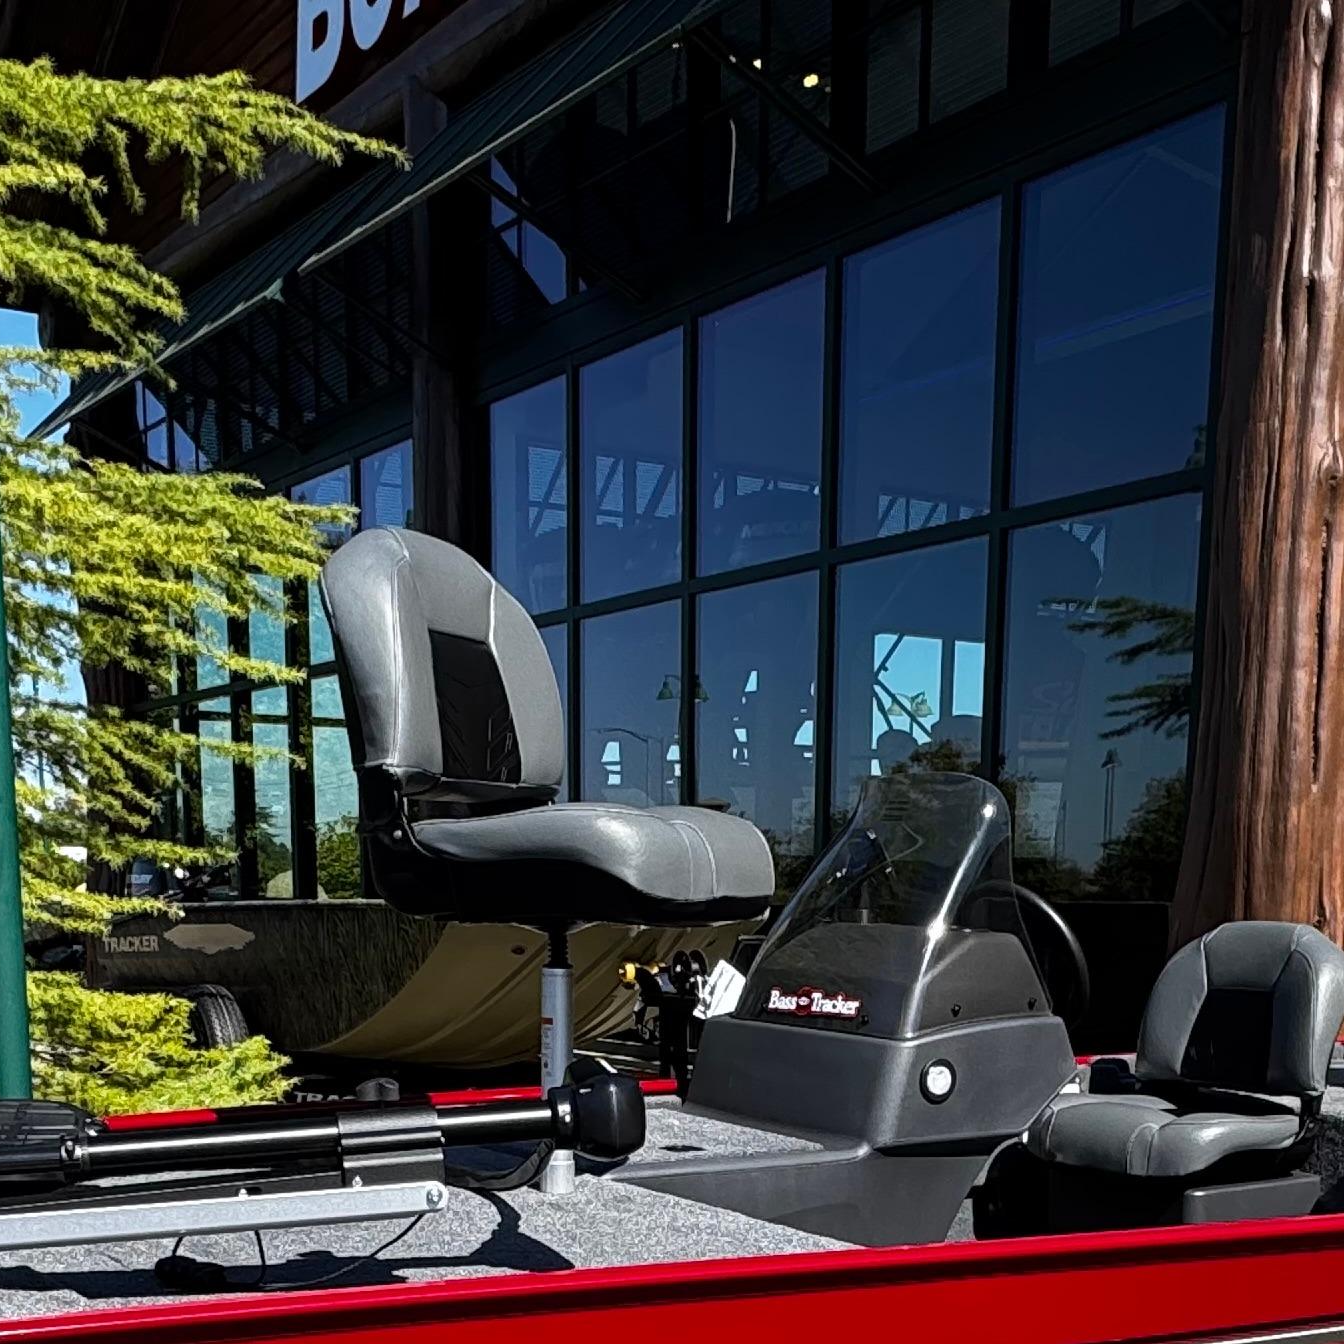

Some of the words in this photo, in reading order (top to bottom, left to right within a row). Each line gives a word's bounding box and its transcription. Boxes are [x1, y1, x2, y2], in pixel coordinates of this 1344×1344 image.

[104, 935, 160, 953] TRACKER
[768, 989, 797, 1010] Bass
[811, 992, 861, 1015] Tracker
